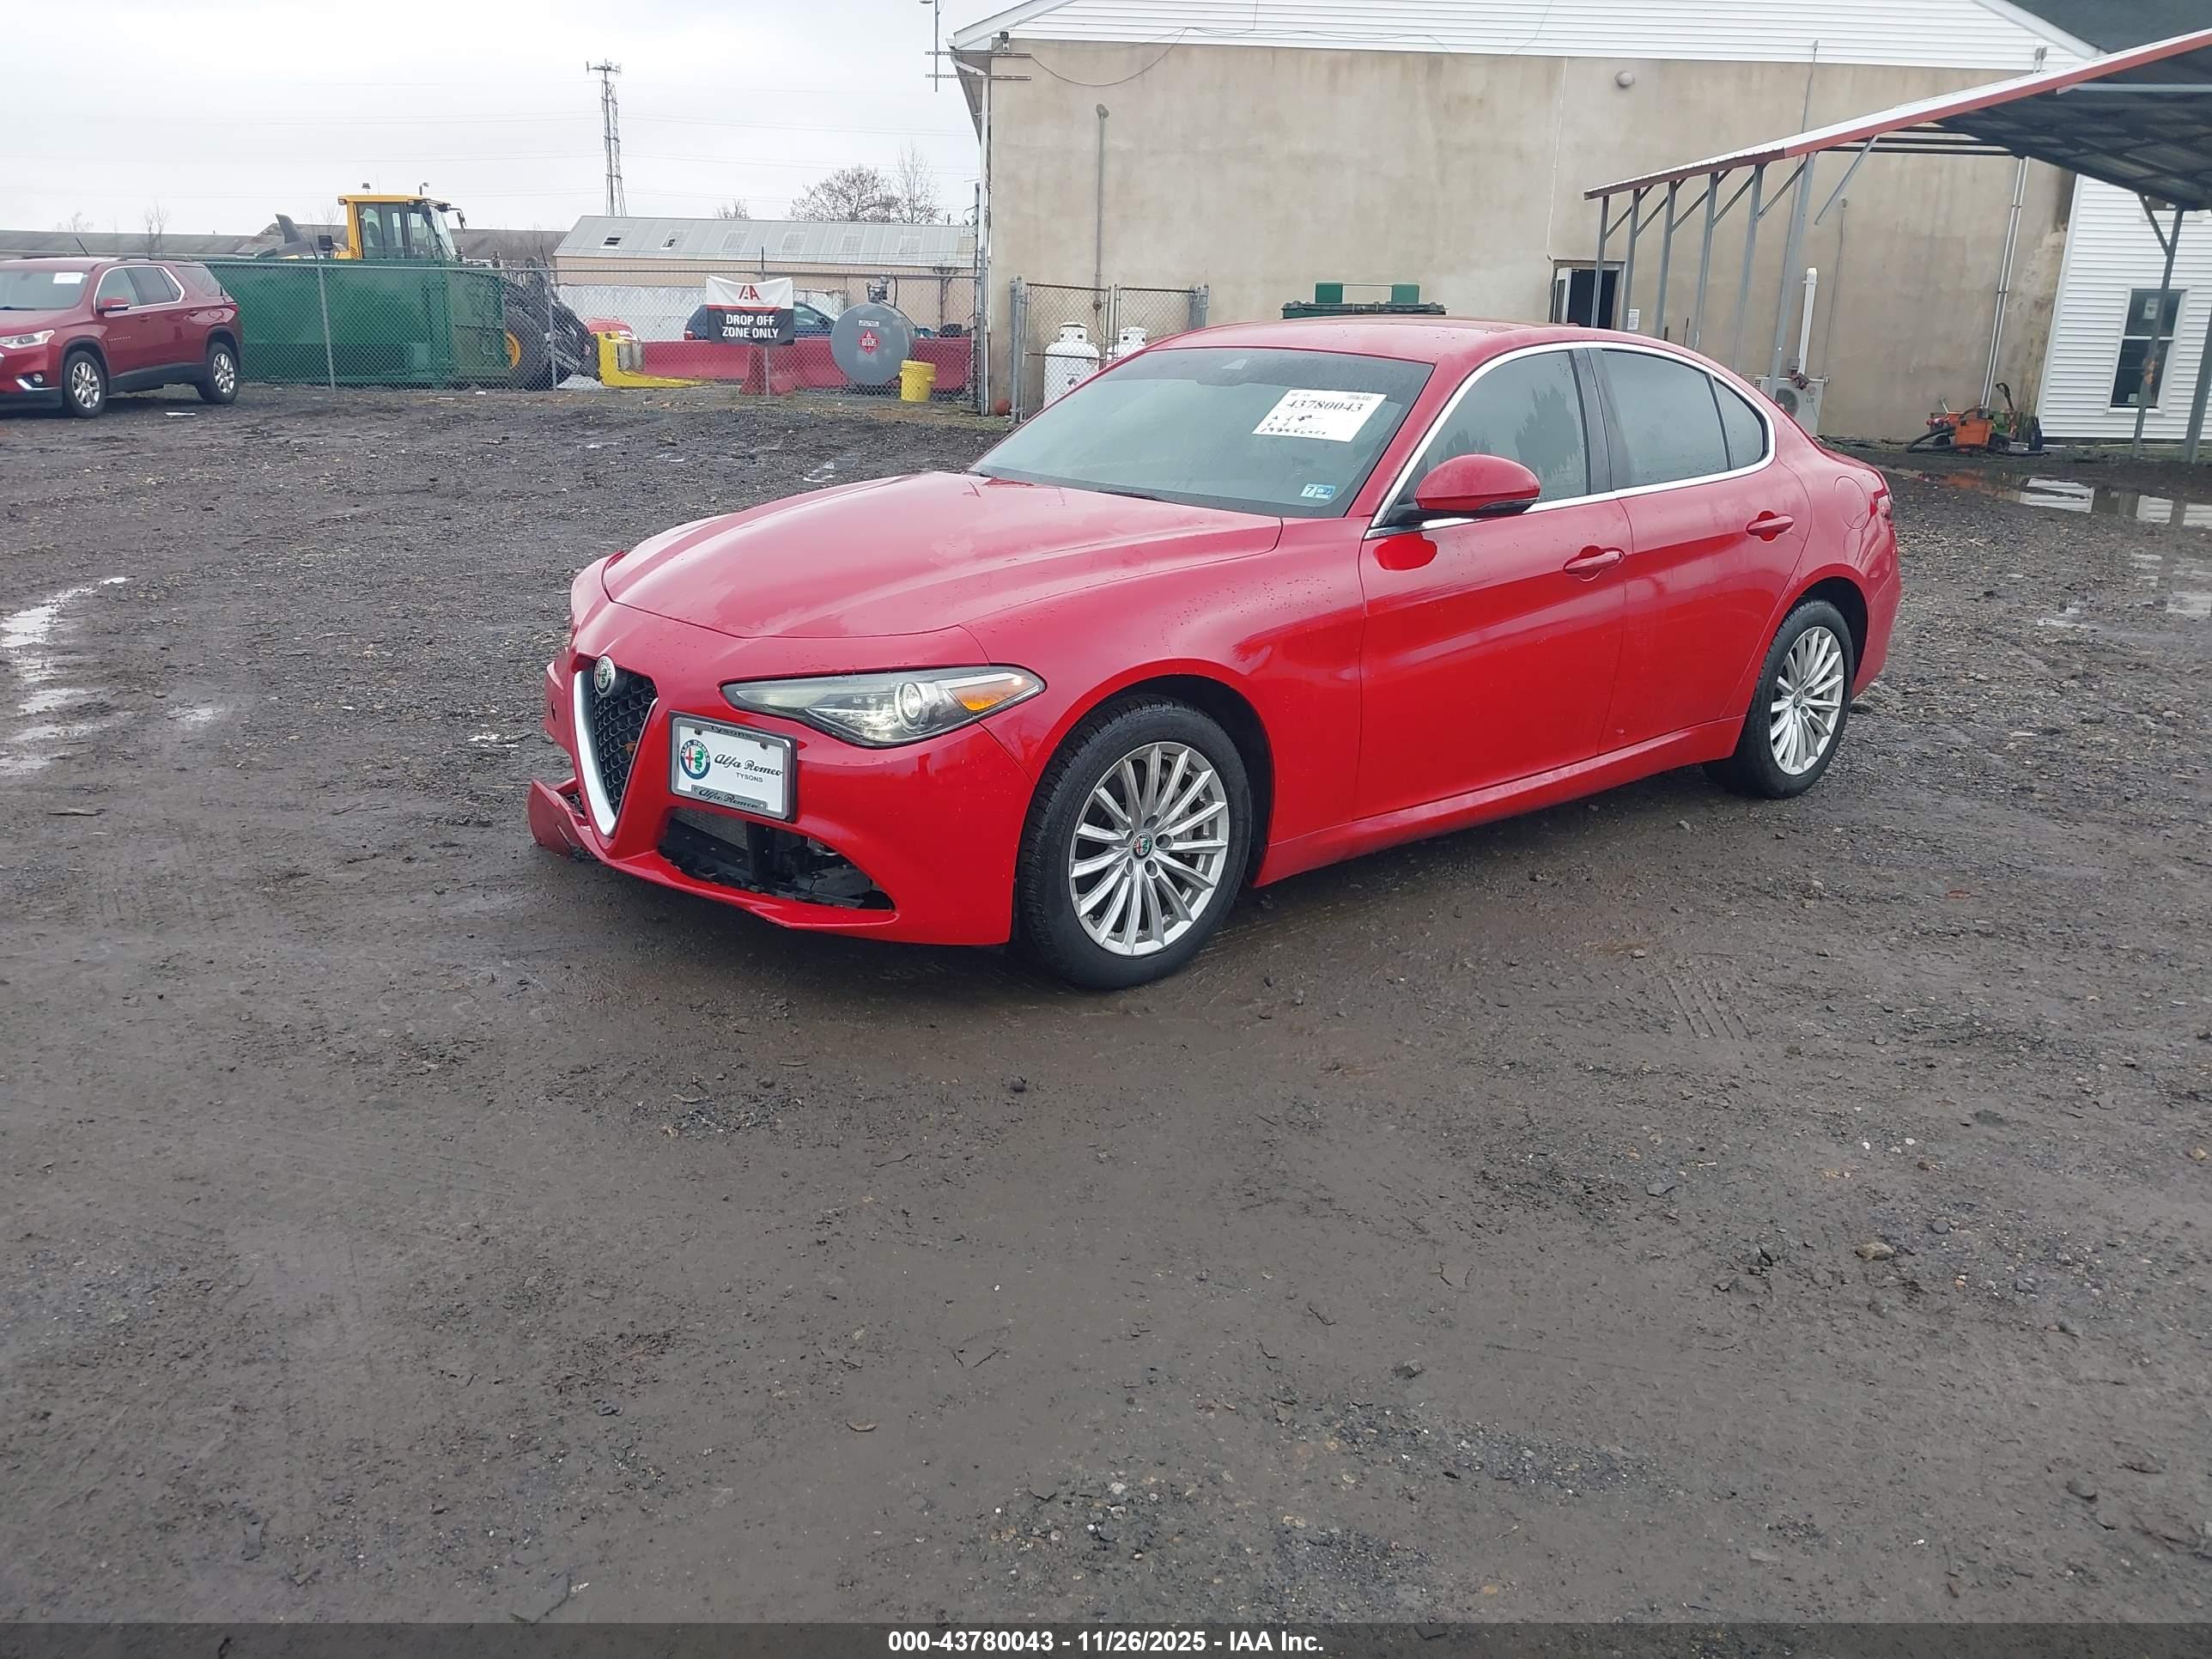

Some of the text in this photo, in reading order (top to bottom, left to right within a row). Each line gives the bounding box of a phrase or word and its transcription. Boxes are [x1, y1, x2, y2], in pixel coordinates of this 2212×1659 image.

[726, 313, 775, 326] DROP OFF
[721, 326, 779, 338] ZONE ONLY
[1286, 399, 1364, 412] 43780043
[693, 740, 710, 763] ROMEO
[714, 753, 783, 776] Alfa Romeo
[736, 772, 763, 783] TYSONS
[698, 788, 759, 809] Alfa Romeo
